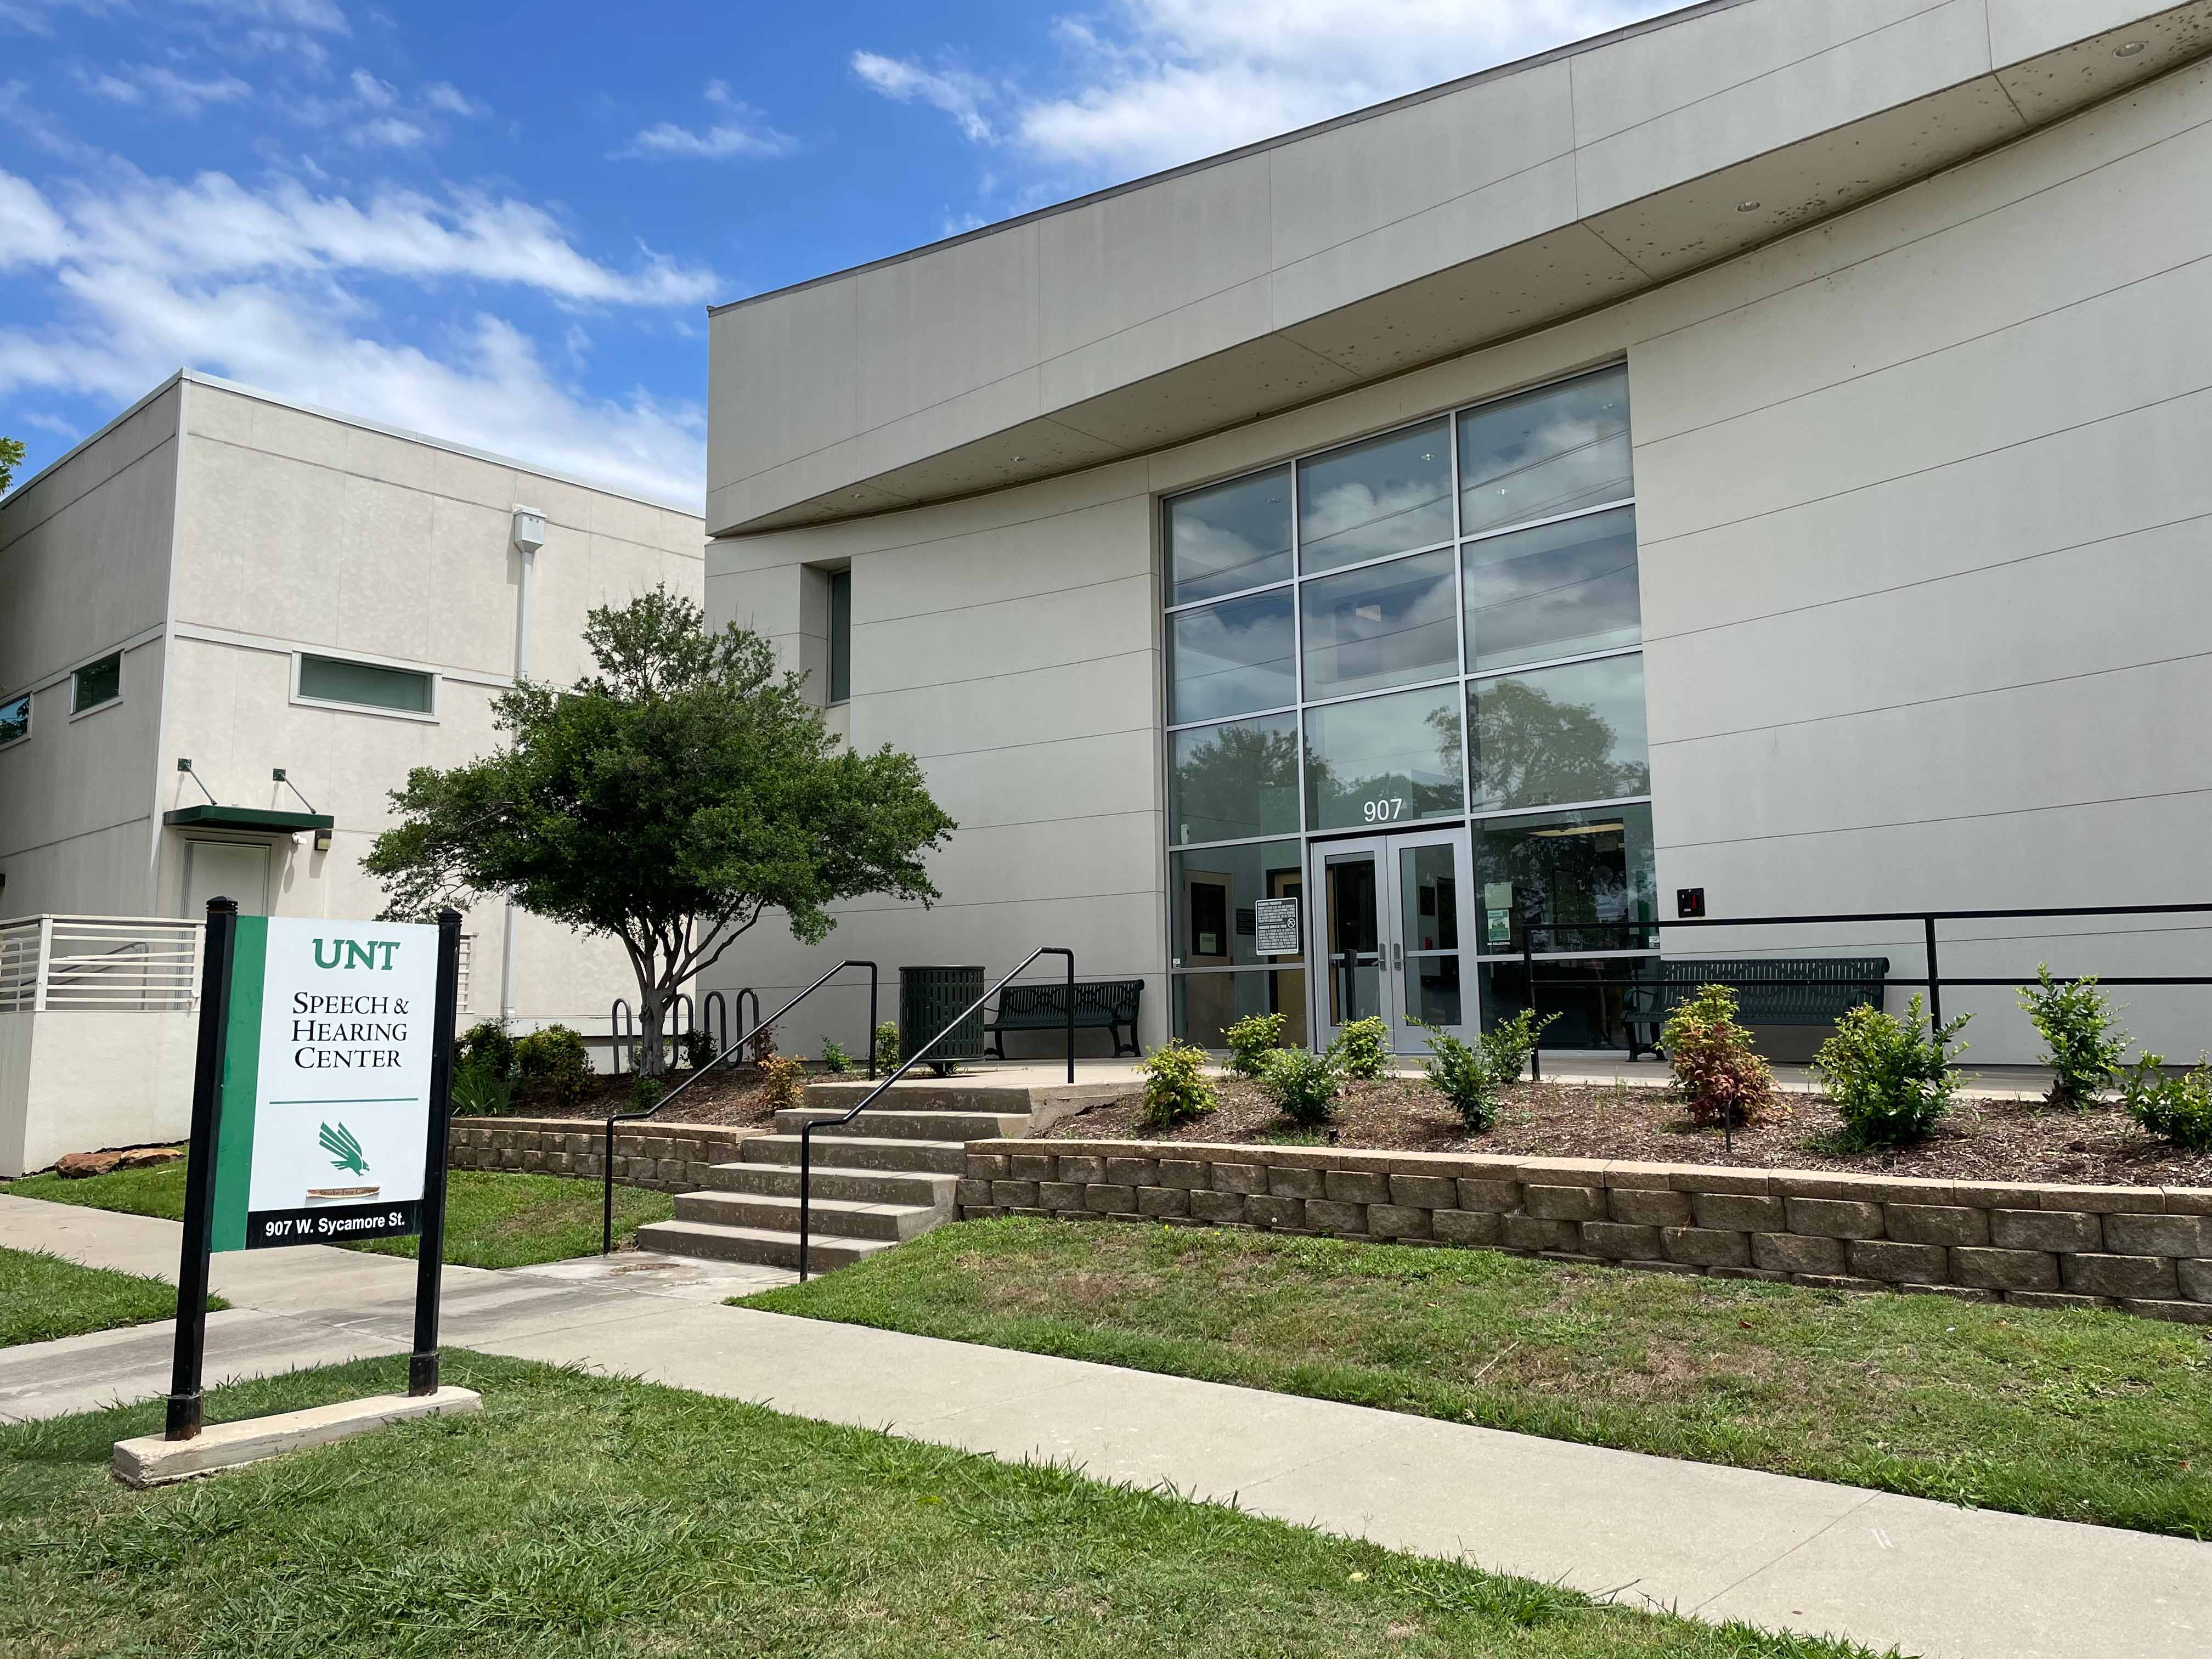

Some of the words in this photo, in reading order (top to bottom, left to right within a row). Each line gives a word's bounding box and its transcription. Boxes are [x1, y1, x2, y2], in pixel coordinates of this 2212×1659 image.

[1364, 798, 1402, 822] 907
[312, 939, 401, 970] UNT
[293, 992, 388, 1014] SPEECH
[394, 998, 410, 1014] &
[291, 1020, 408, 1041] HEARING
[295, 1047, 402, 1069] CENTER
[266, 1221, 292, 1237] 907
[296, 1219, 314, 1234] W.
[318, 1216, 385, 1235] Sycamore
[388, 1212, 405, 1226] St.
